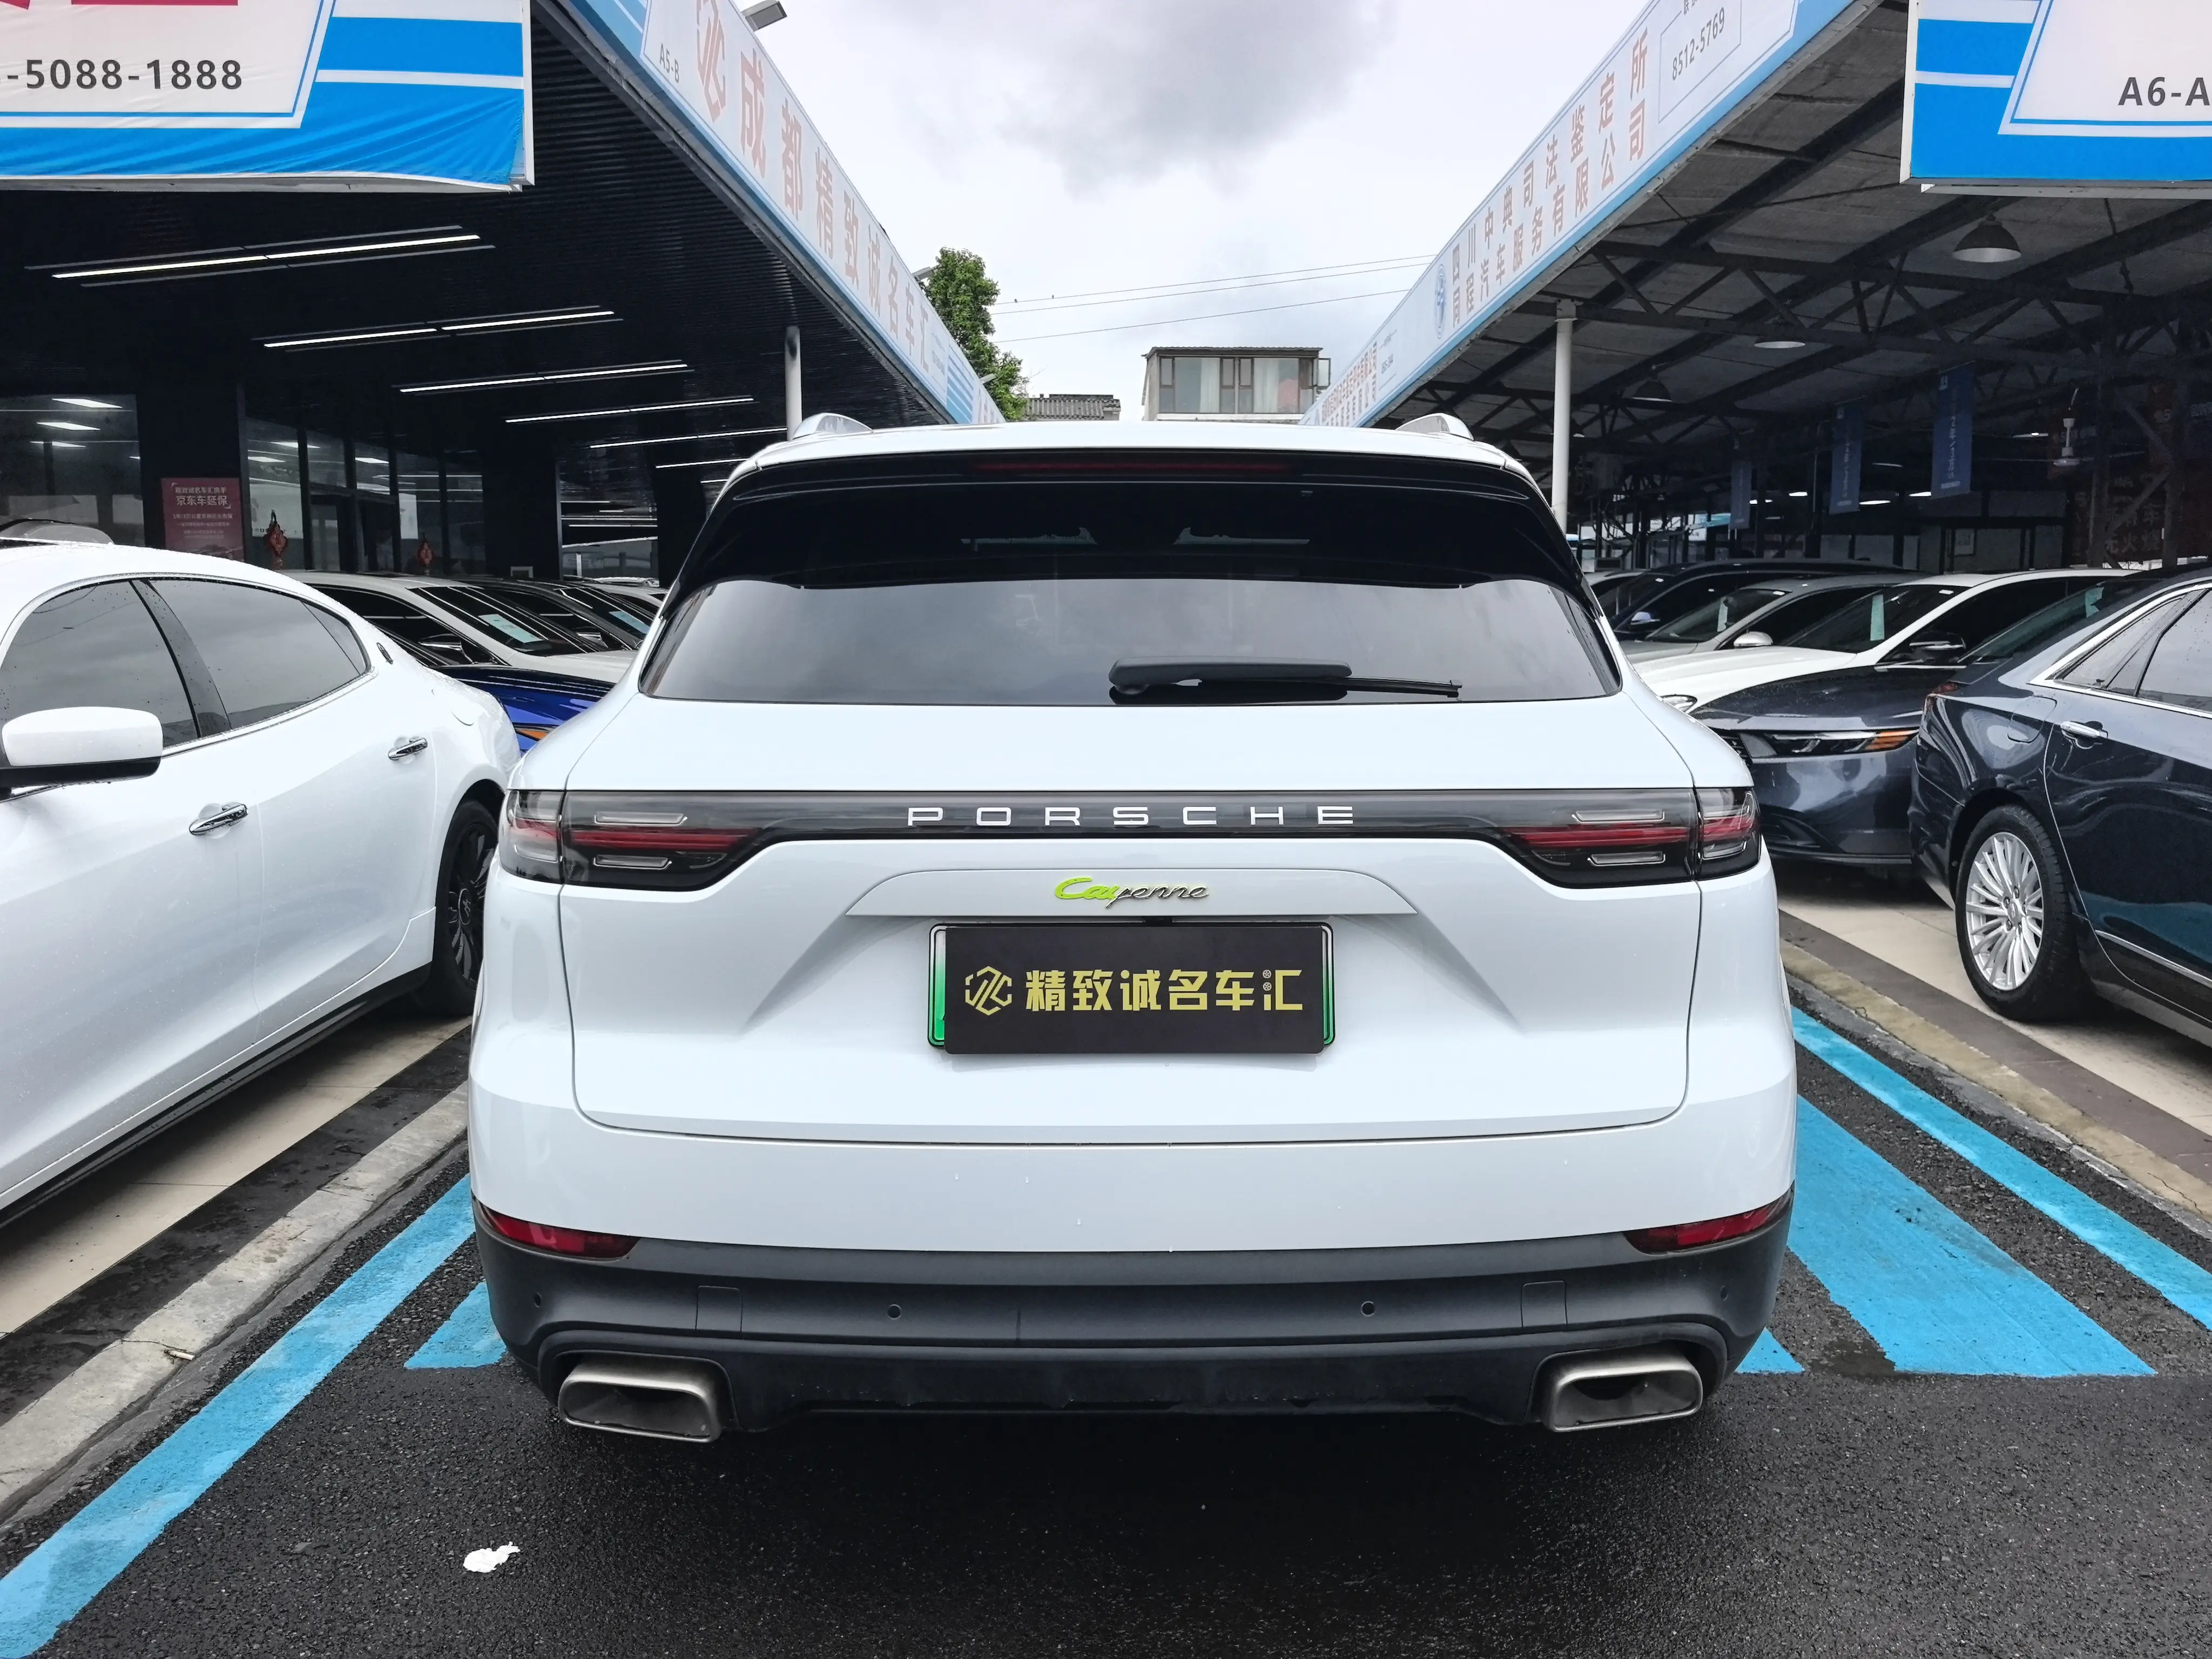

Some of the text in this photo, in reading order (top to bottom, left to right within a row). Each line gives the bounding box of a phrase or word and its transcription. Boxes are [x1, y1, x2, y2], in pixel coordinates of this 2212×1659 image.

[659, 43, 679, 84] A5-B
[1673, 7, 1725, 80] 8512-5769
[0, 59, 242, 89] -5088-1888
[2118, 77, 2210, 106] A6-A
[1453, 27, 1648, 285] 四川中典司法鉴定所
[740, 48, 929, 374] 成都精致诚名车汇
[1453, 98, 1645, 328] 同程汽车服务有限公司
[176, 495, 227, 505] 京东车延保
[907, 805, 1354, 827] PORSCHE
[1054, 876, 1210, 908] Cayenne
[1025, 969, 1303, 1012] 精致诚名车汇
